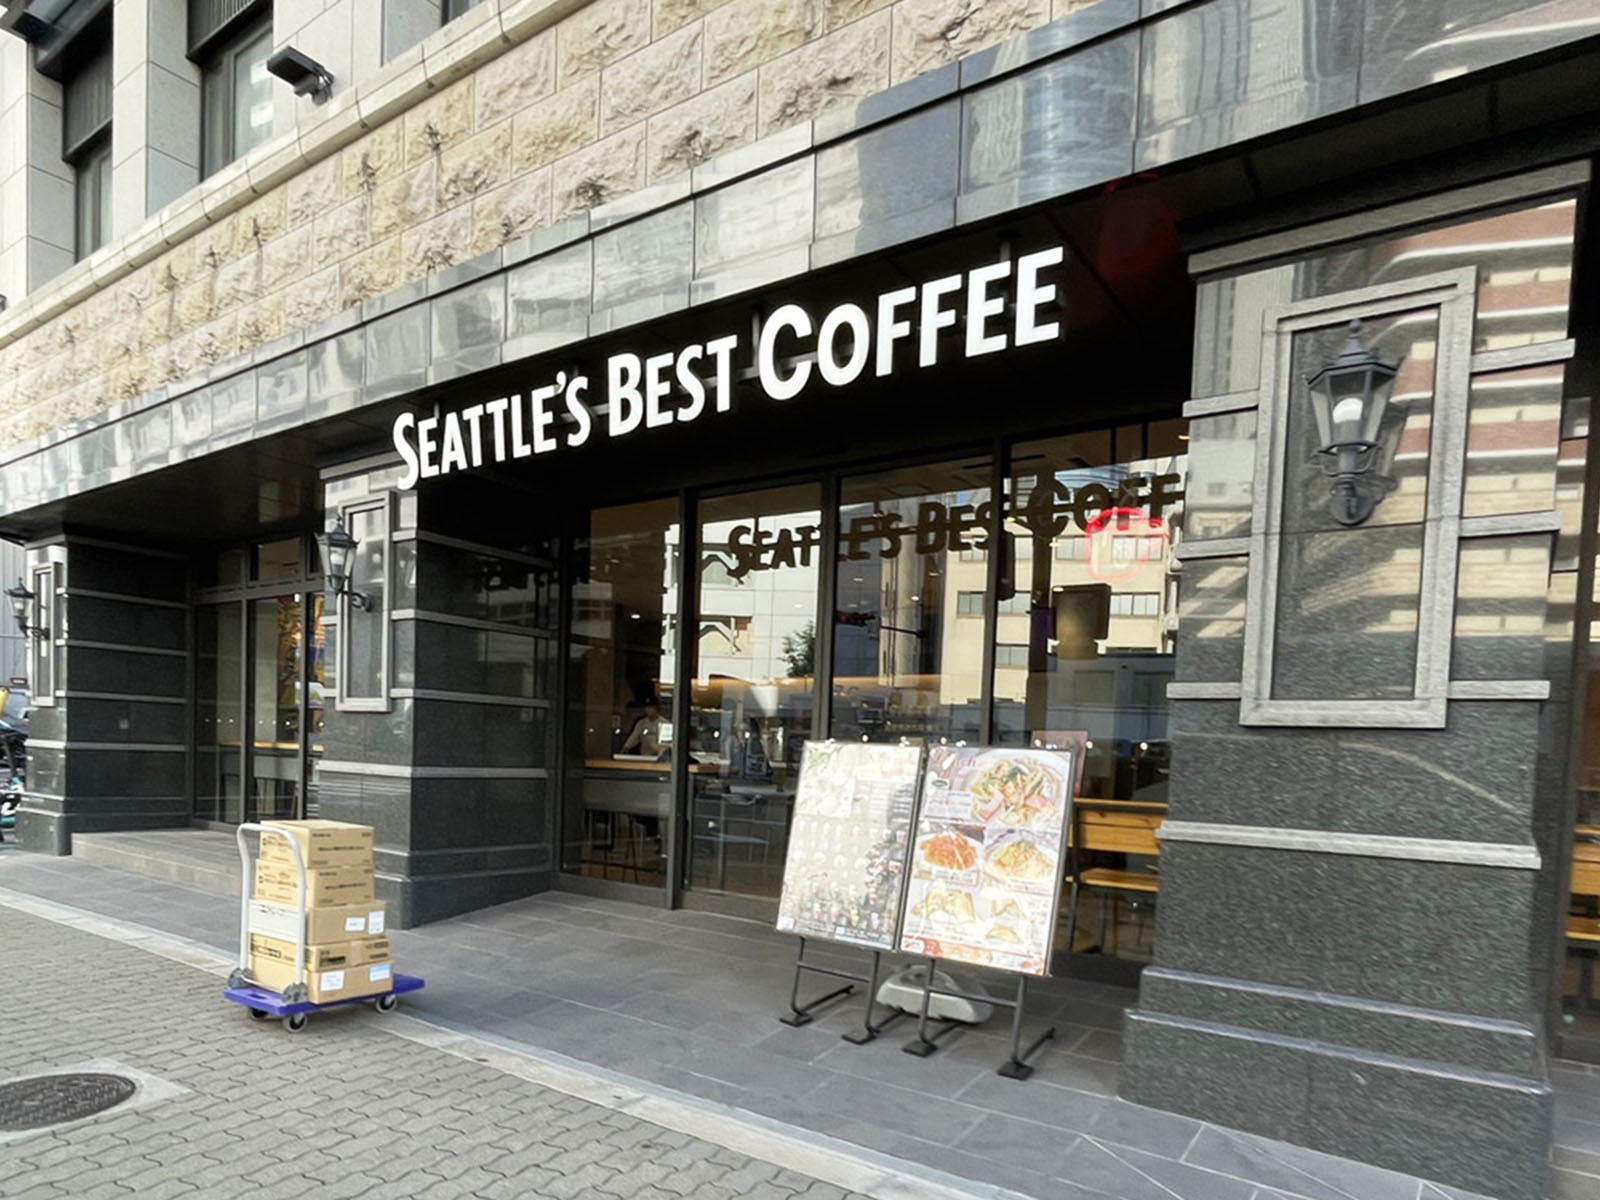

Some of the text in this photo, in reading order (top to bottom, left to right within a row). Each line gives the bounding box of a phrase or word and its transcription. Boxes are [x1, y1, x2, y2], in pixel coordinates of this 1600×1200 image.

[392, 246, 1063, 490] SEATTLE'S BEST COFFEE
